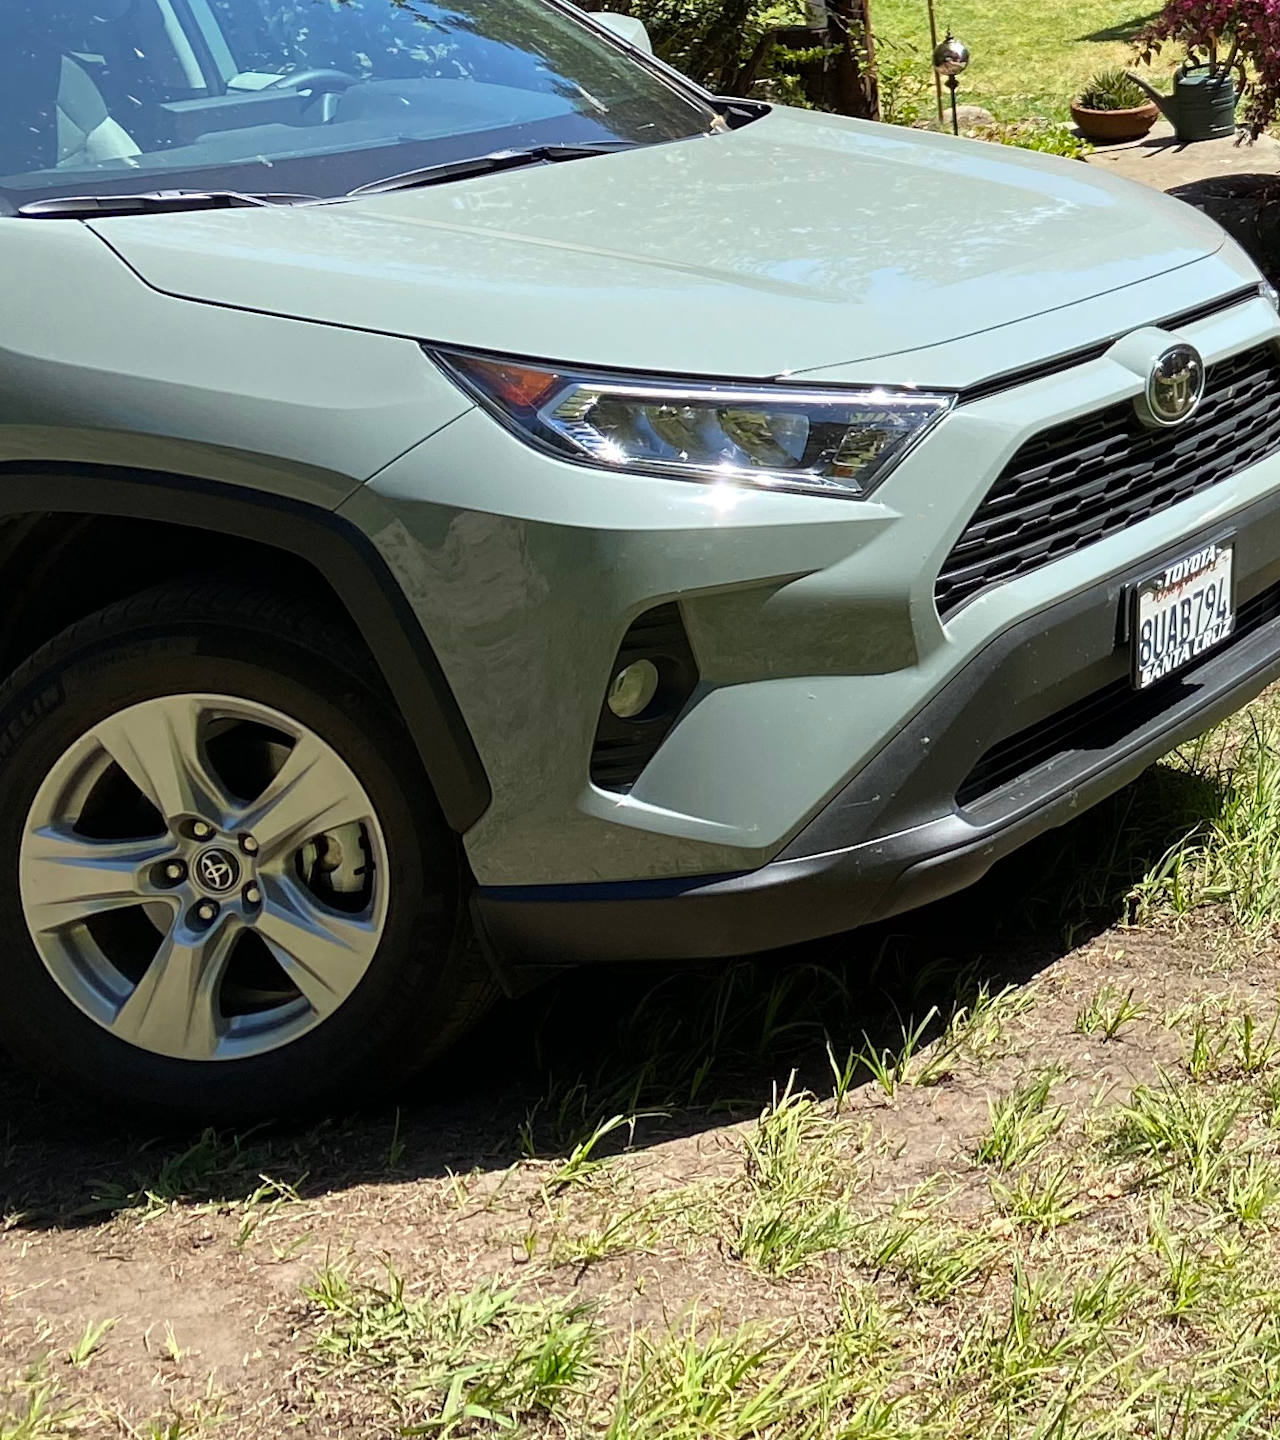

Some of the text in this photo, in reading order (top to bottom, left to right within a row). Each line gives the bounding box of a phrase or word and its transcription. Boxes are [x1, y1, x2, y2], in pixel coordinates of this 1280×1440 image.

[1164, 545, 1216, 588] TOYOTA
[1140, 576, 1228, 667] 8UAB794
[1141, 615, 1233, 688] SANTA CRUZ
